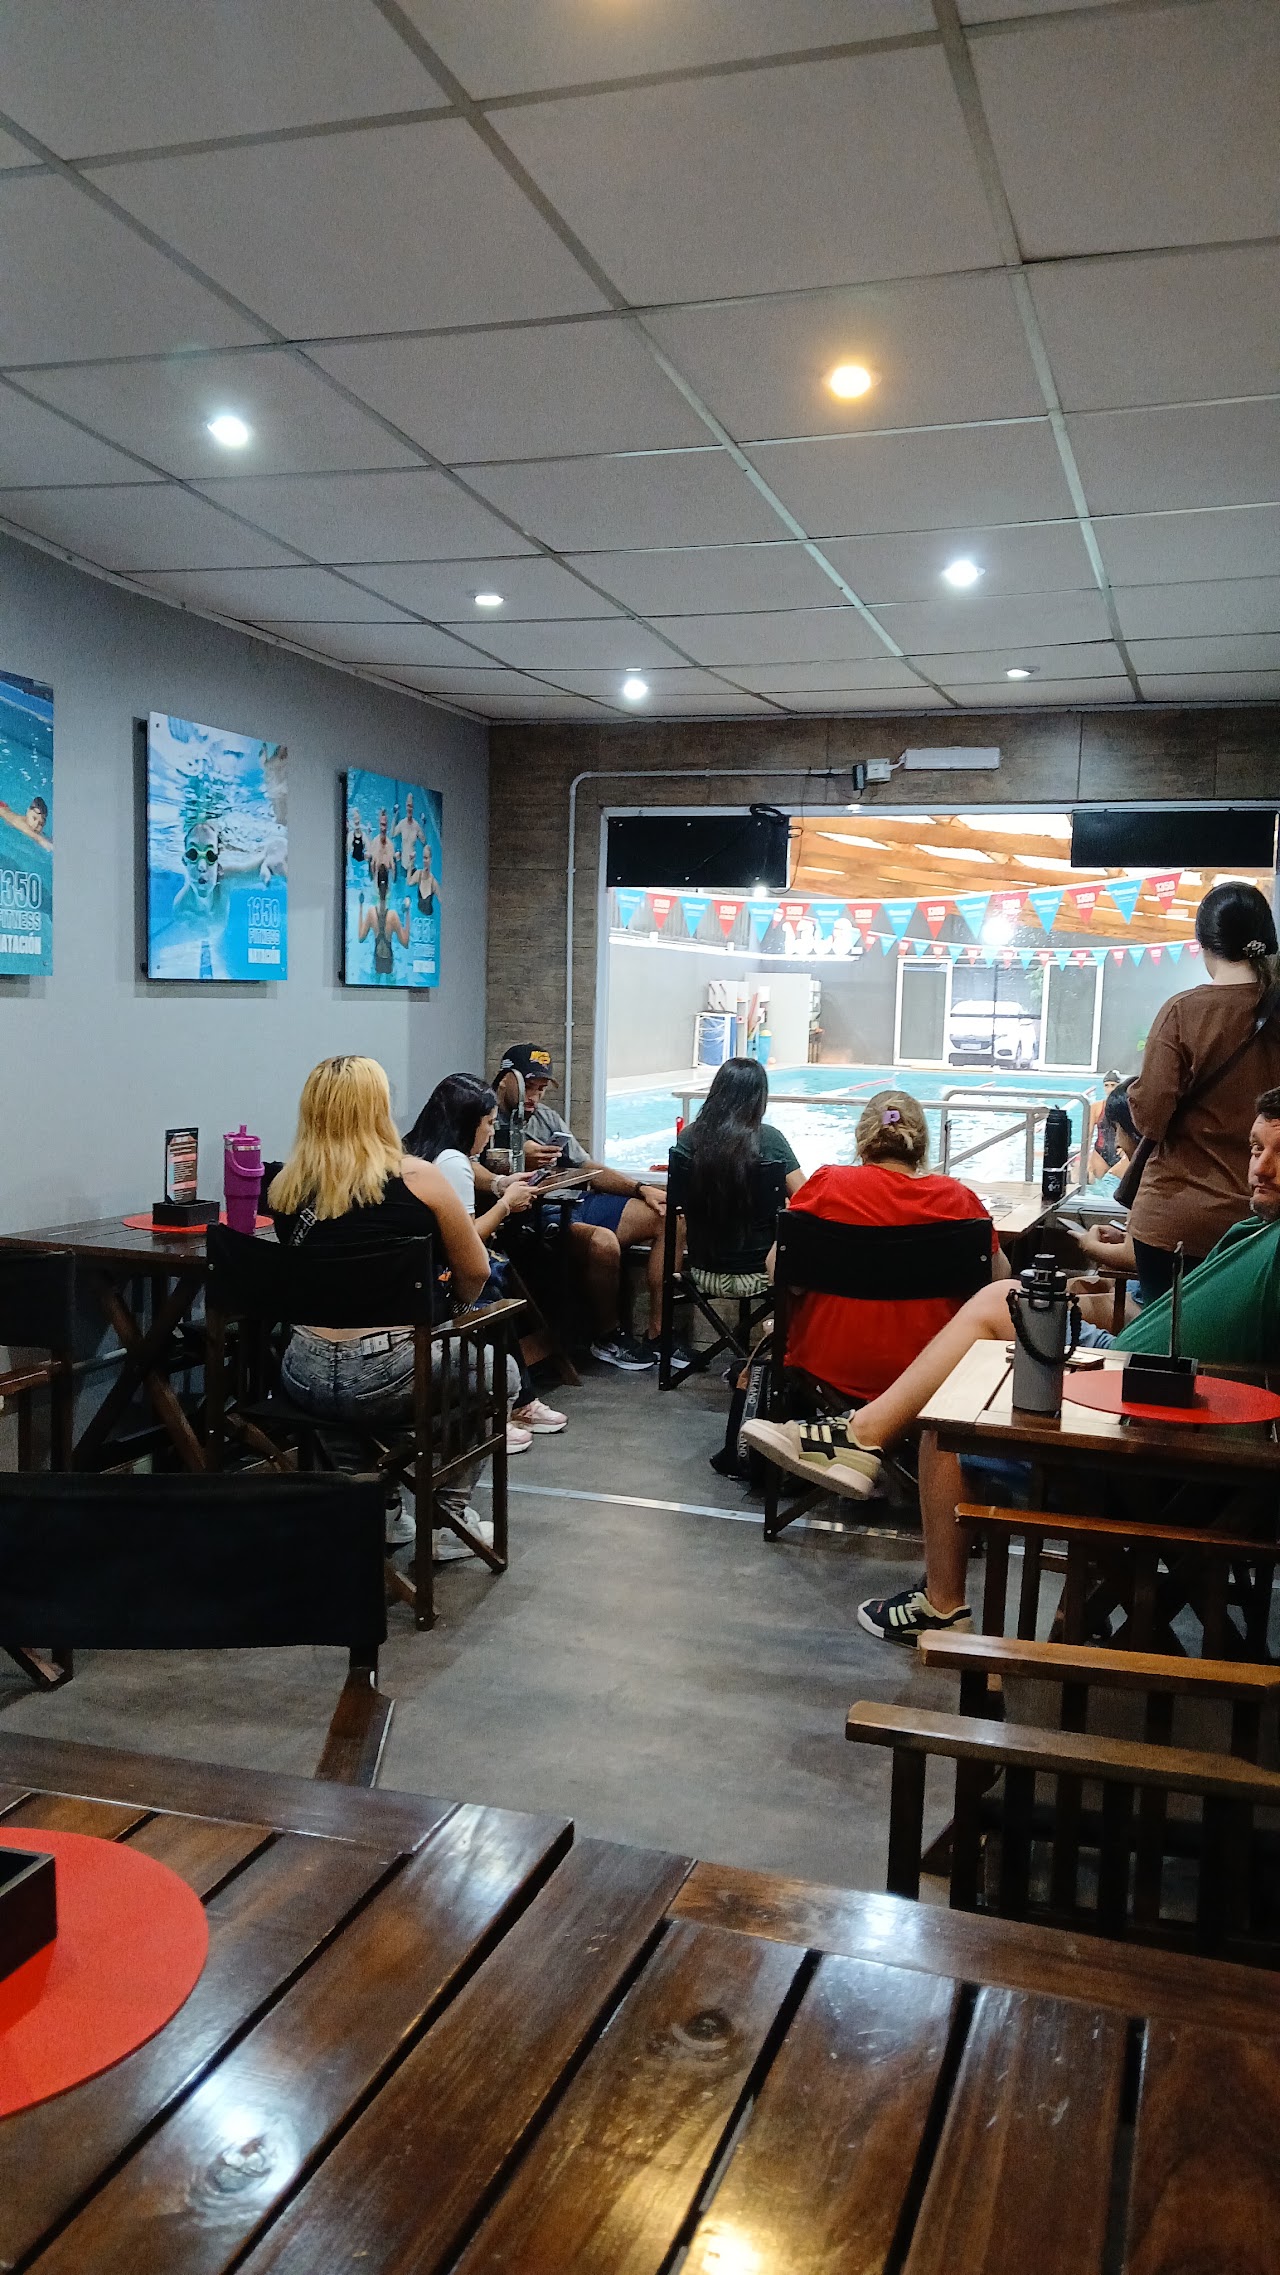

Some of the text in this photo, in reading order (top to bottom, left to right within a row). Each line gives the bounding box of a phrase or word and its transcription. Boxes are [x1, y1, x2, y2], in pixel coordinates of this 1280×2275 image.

[0, 869, 42, 909] 350
[0, 908, 41, 931] ITNESS
[247, 896, 280, 928] 1350
[0, 931, 42, 954] ATACIÓN
